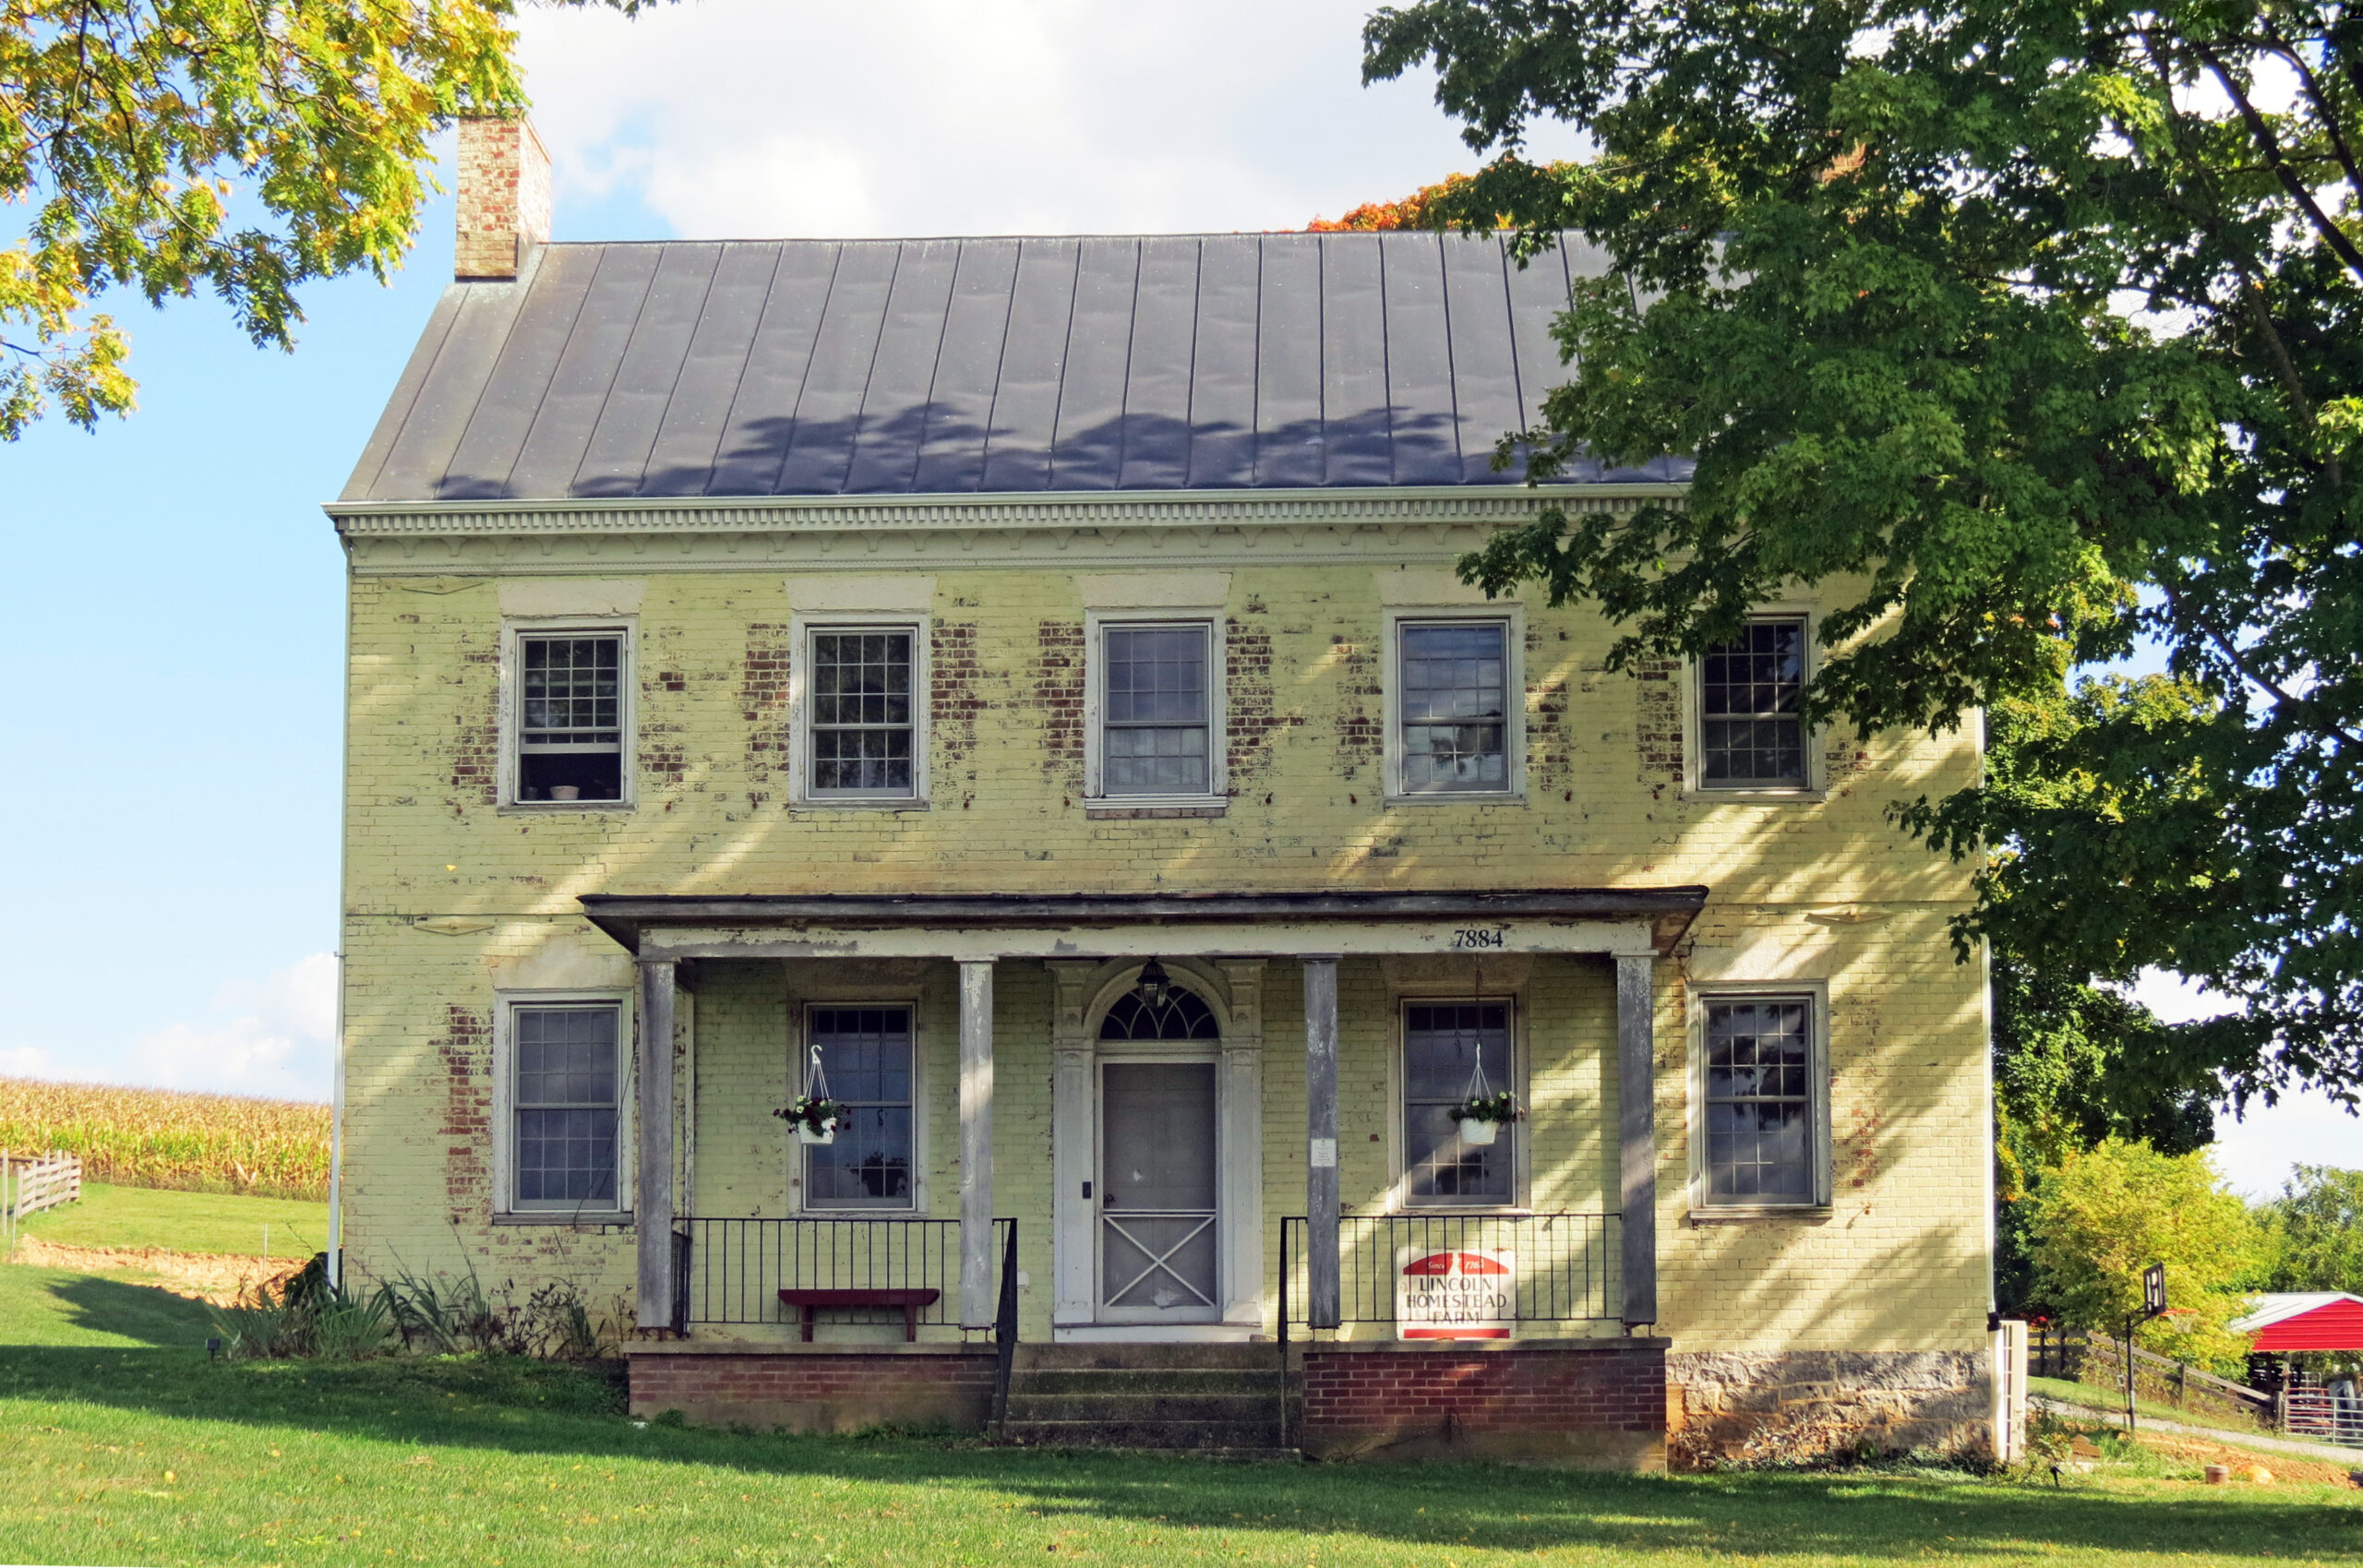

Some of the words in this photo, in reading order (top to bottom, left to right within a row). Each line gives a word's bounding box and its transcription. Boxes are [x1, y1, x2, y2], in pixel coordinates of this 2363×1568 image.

[1454, 929, 1503, 948] 7884
[1420, 1277, 1492, 1291] LINCOLN
[1407, 1294, 1506, 1308] HOMESTEAD
[1433, 1311, 1479, 1324] FARM
